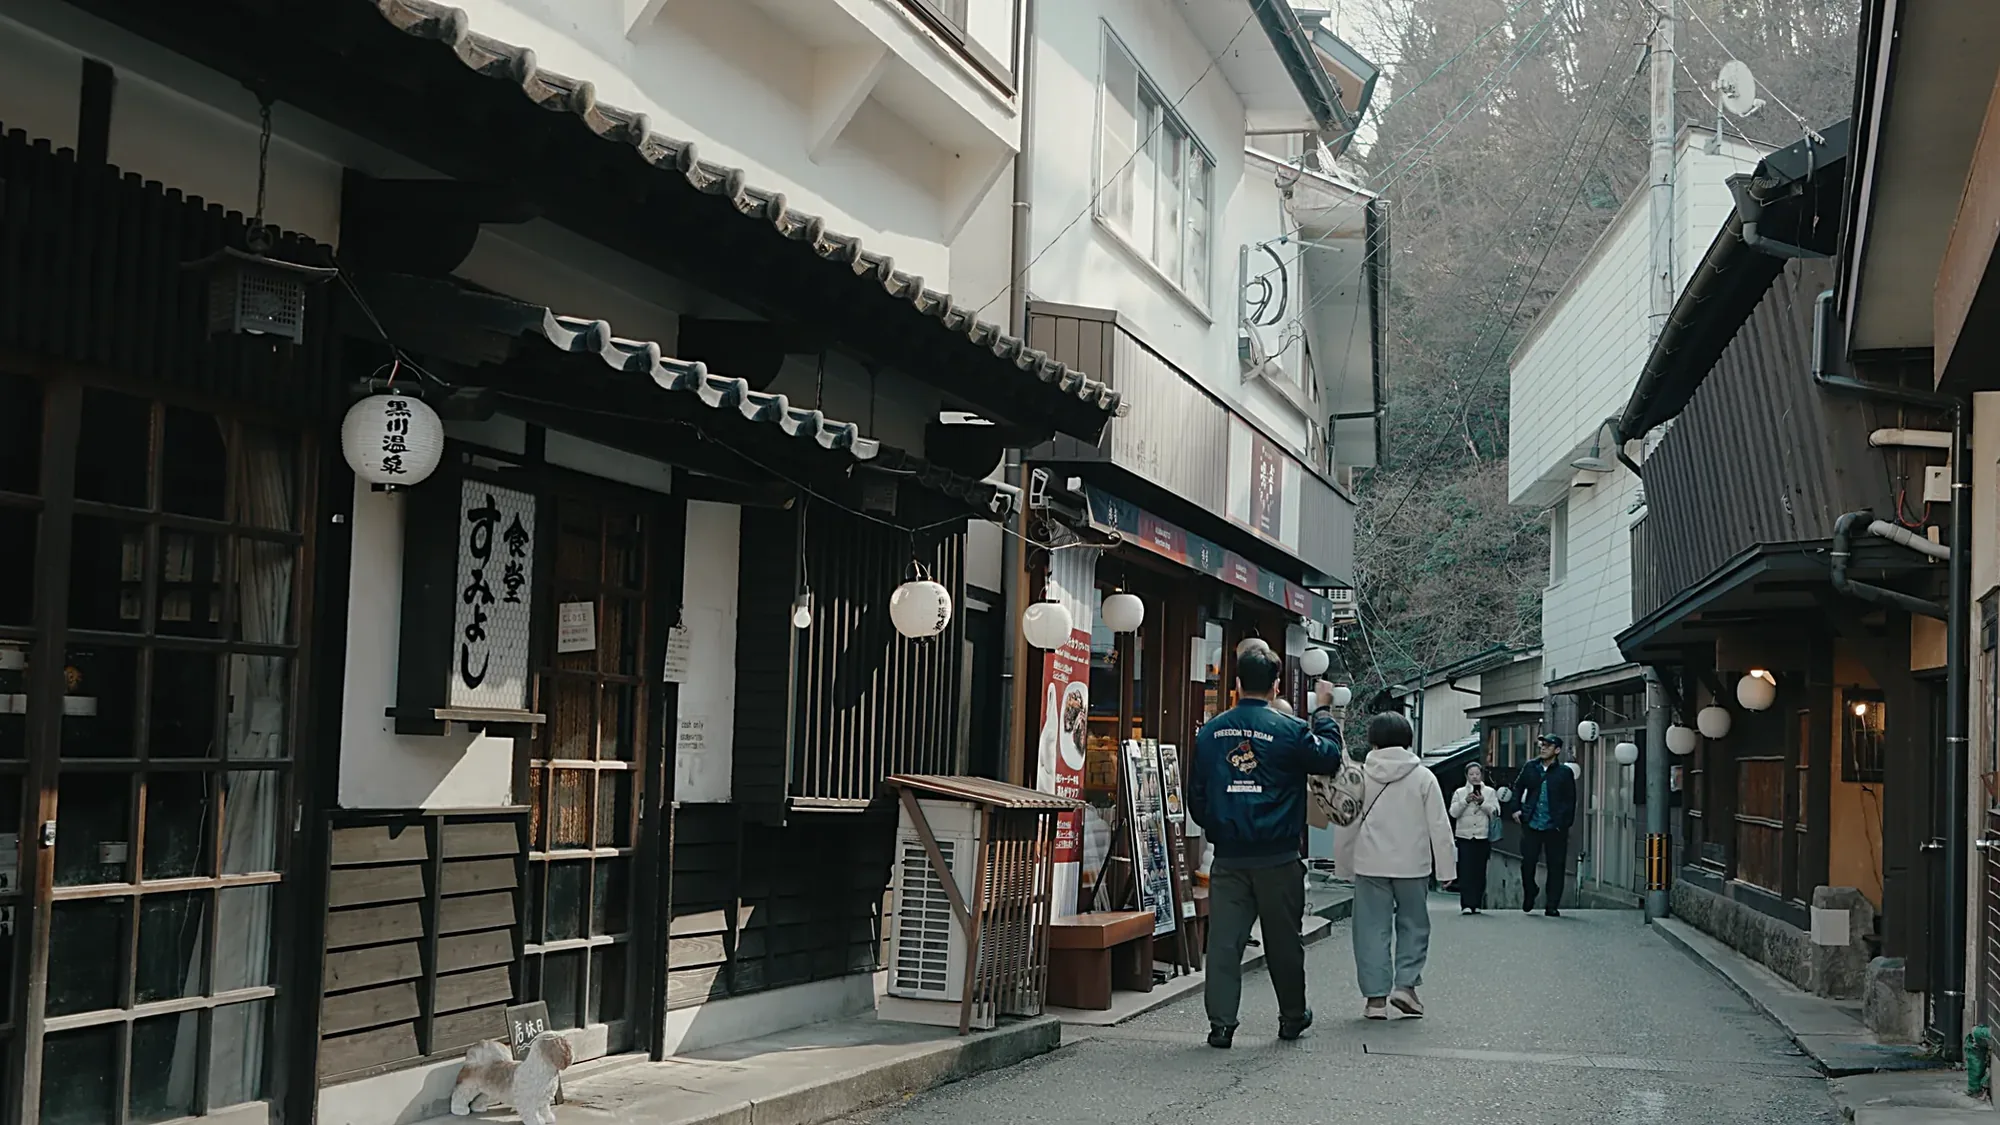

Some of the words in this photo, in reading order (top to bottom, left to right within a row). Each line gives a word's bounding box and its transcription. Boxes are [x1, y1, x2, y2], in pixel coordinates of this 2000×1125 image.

[380, 400, 411, 475] 黒川温泉
[503, 511, 529, 604] 食堂
[460, 493, 501, 689] すみよし
[1214, 729, 1242, 738] FREEDOM
[1243, 729, 1252, 737] TO
[1254, 731, 1274, 742] ROAM
[1226, 785, 1262, 793] AMERICAN
[514, 1018, 544, 1046] 店休日
